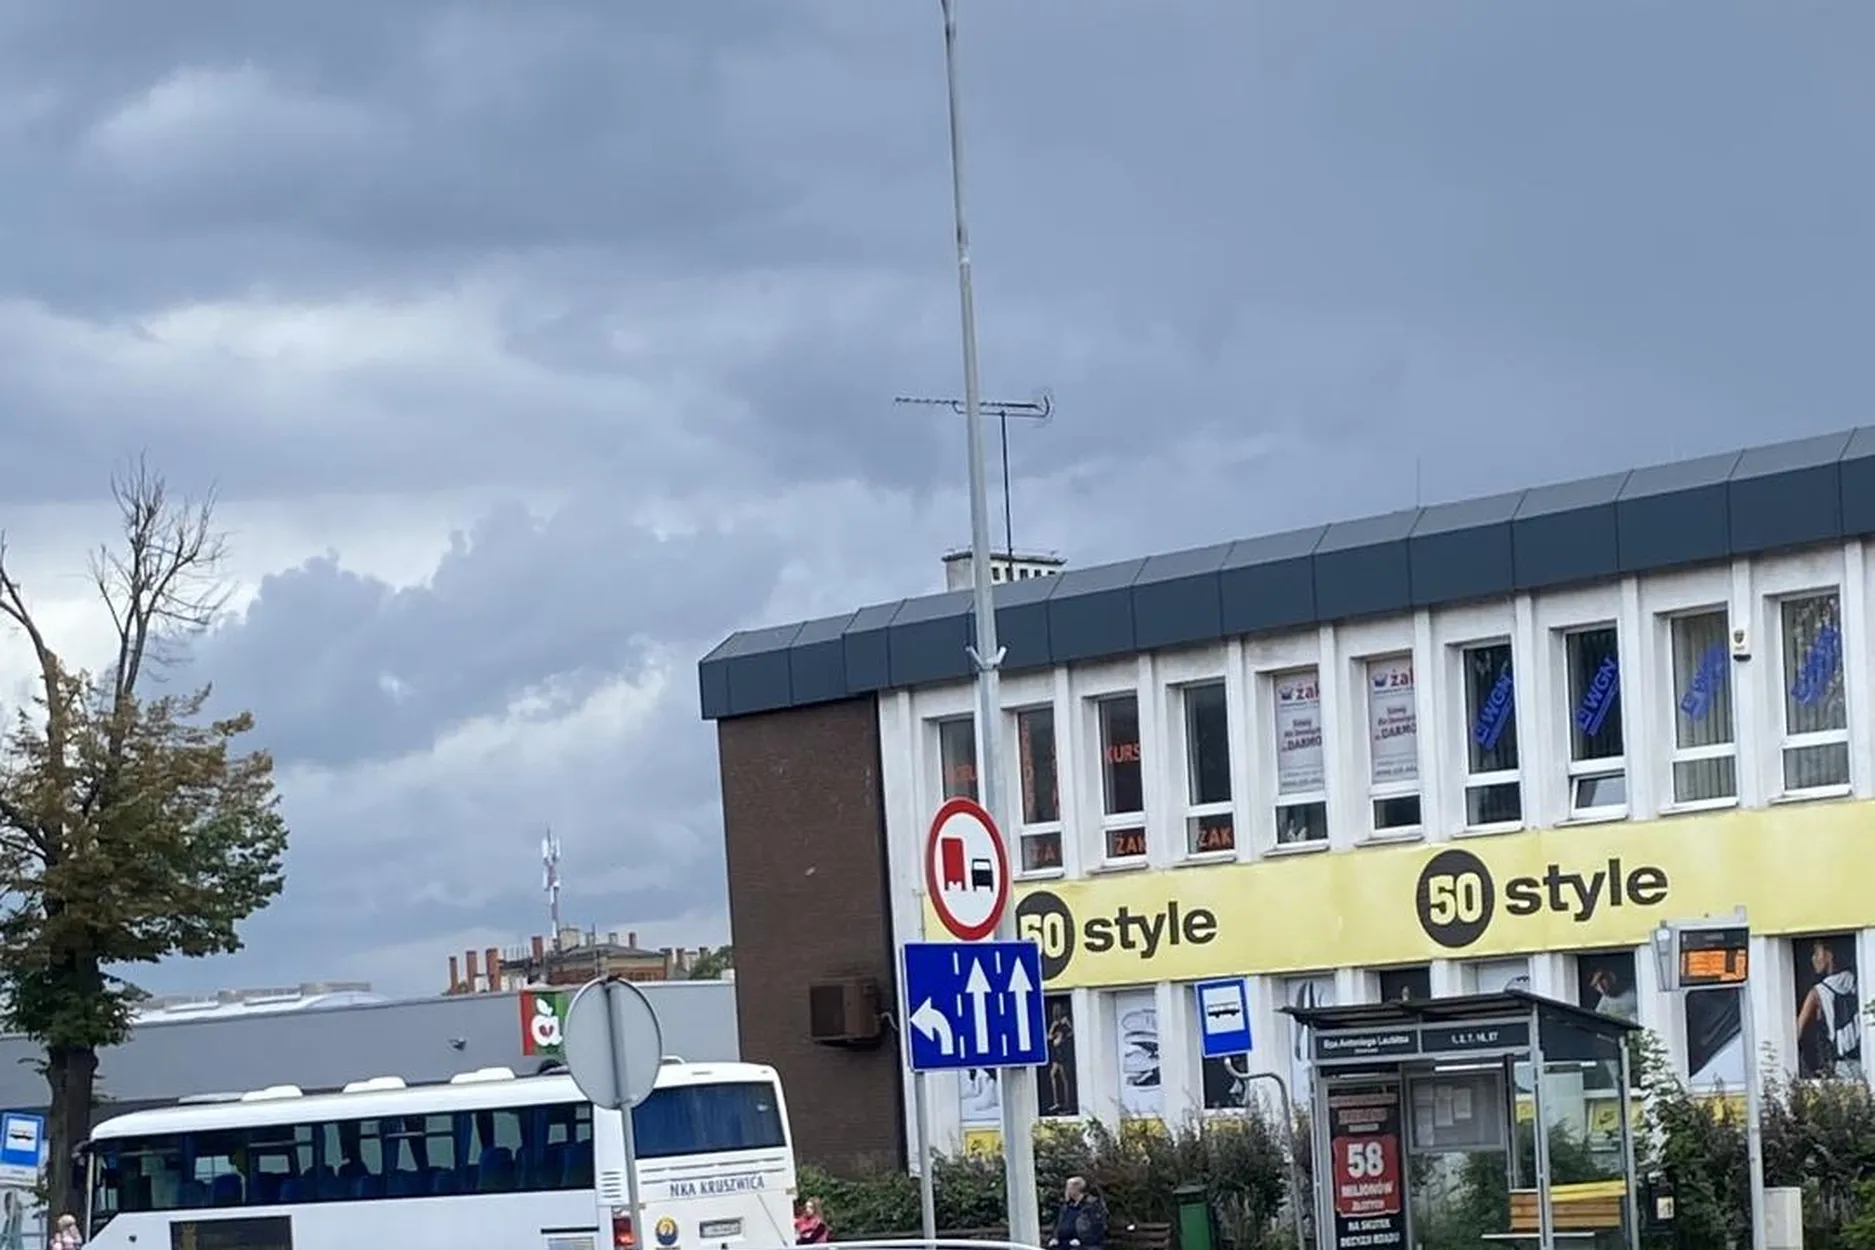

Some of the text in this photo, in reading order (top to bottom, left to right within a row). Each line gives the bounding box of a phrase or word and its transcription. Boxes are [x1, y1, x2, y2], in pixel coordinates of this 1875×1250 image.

[1583, 656, 1617, 709] WGN
[1428, 858, 1668, 925] 50 style
[1084, 901, 1217, 959] style
[700, 1175, 765, 1195] KRUSZWICA
[1347, 1142, 1384, 1178] 58
